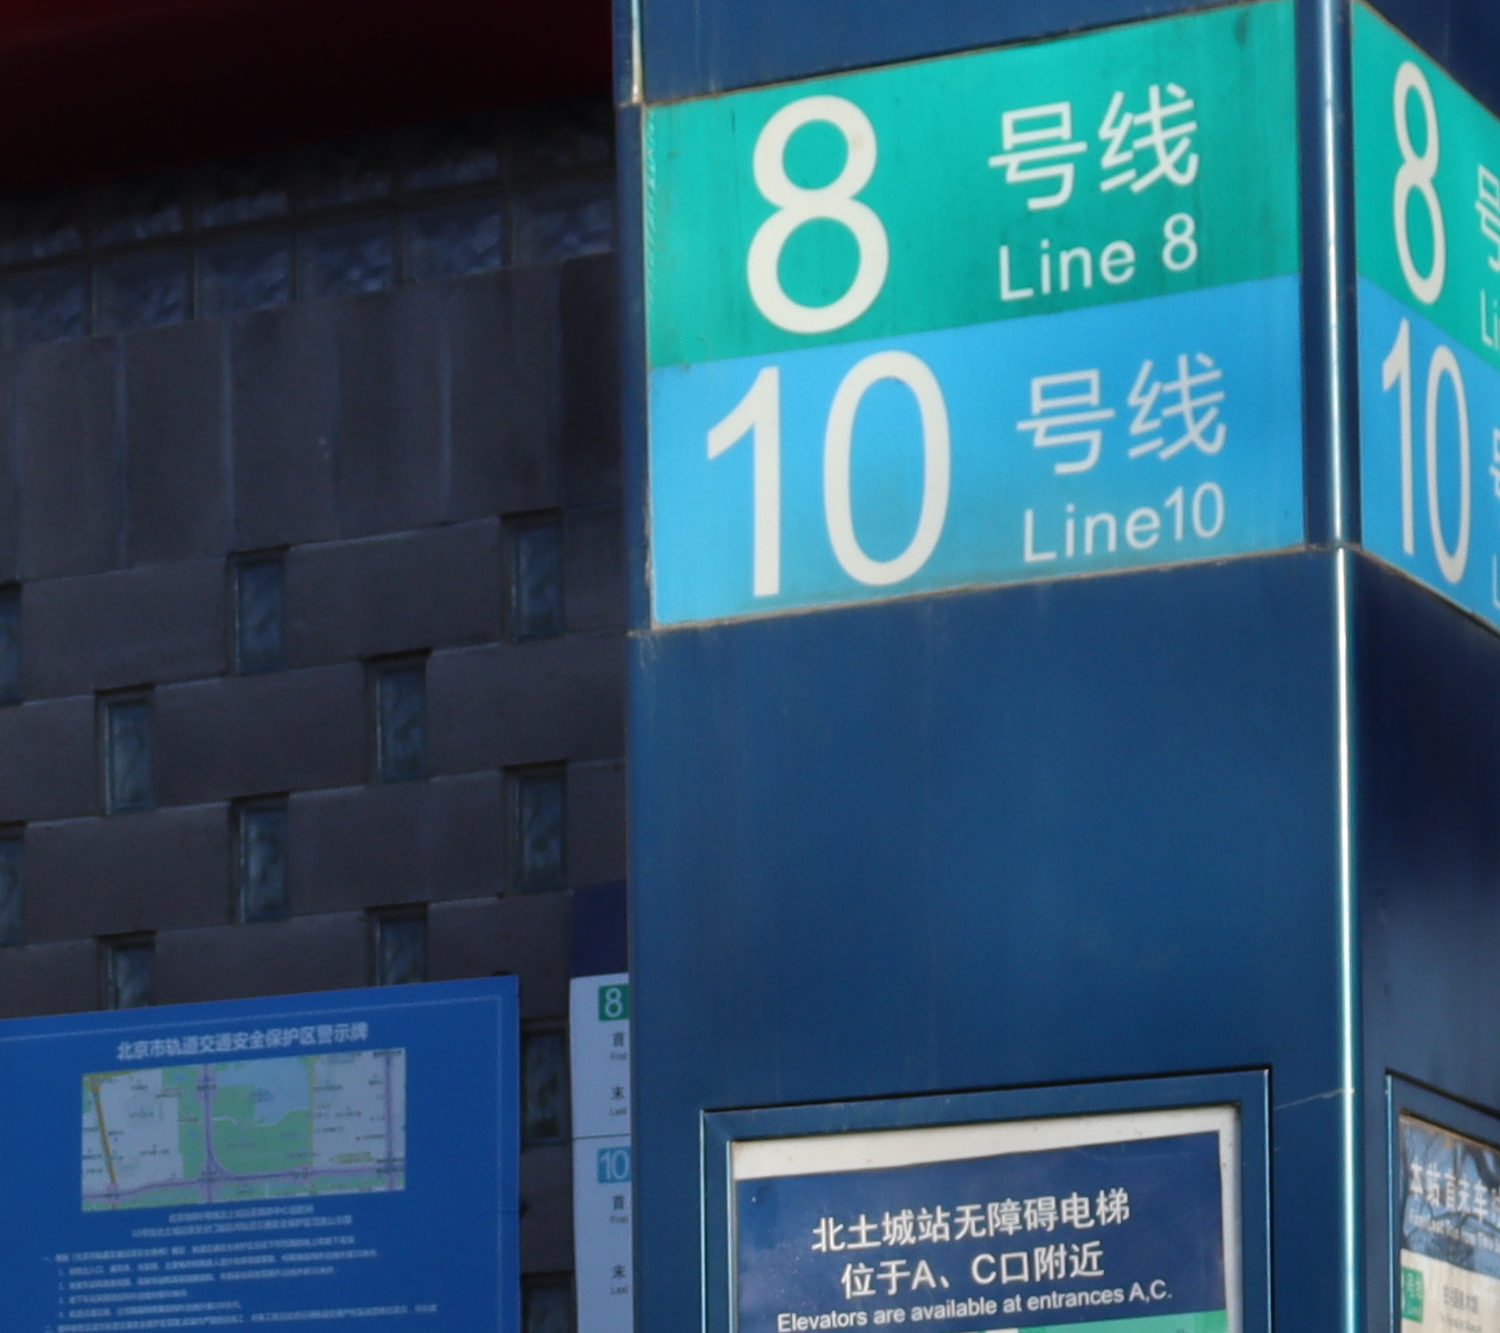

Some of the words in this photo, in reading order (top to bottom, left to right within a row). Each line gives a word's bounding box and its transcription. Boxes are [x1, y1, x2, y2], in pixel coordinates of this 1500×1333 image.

[988, 82, 1199, 211] 号线
[1393, 60, 1446, 305] 8
[747, 95, 889, 334] 8
[999, 238, 1136, 301] Line
[1161, 212, 1199, 272] 8
[1016, 352, 1227, 475] 号线
[1381, 317, 1471, 585] 10
[707, 349, 951, 598] 10
[605, 987, 623, 1018] 8
[601, 1150, 629, 1180] 10
[812, 1188, 1130, 1253] 北土城站无障碍电梯
[841, 1241, 1104, 1299] 位于A、C口附近
[777, 1310, 867, 1333] Elevators
[873, 1309, 905, 1325] are
[911, 1297, 997, 1322] available
[1003, 1296, 1022, 1313] at
[1027, 1287, 1124, 1312] entrances
[1128, 1279, 1173, 1305] A,C.
